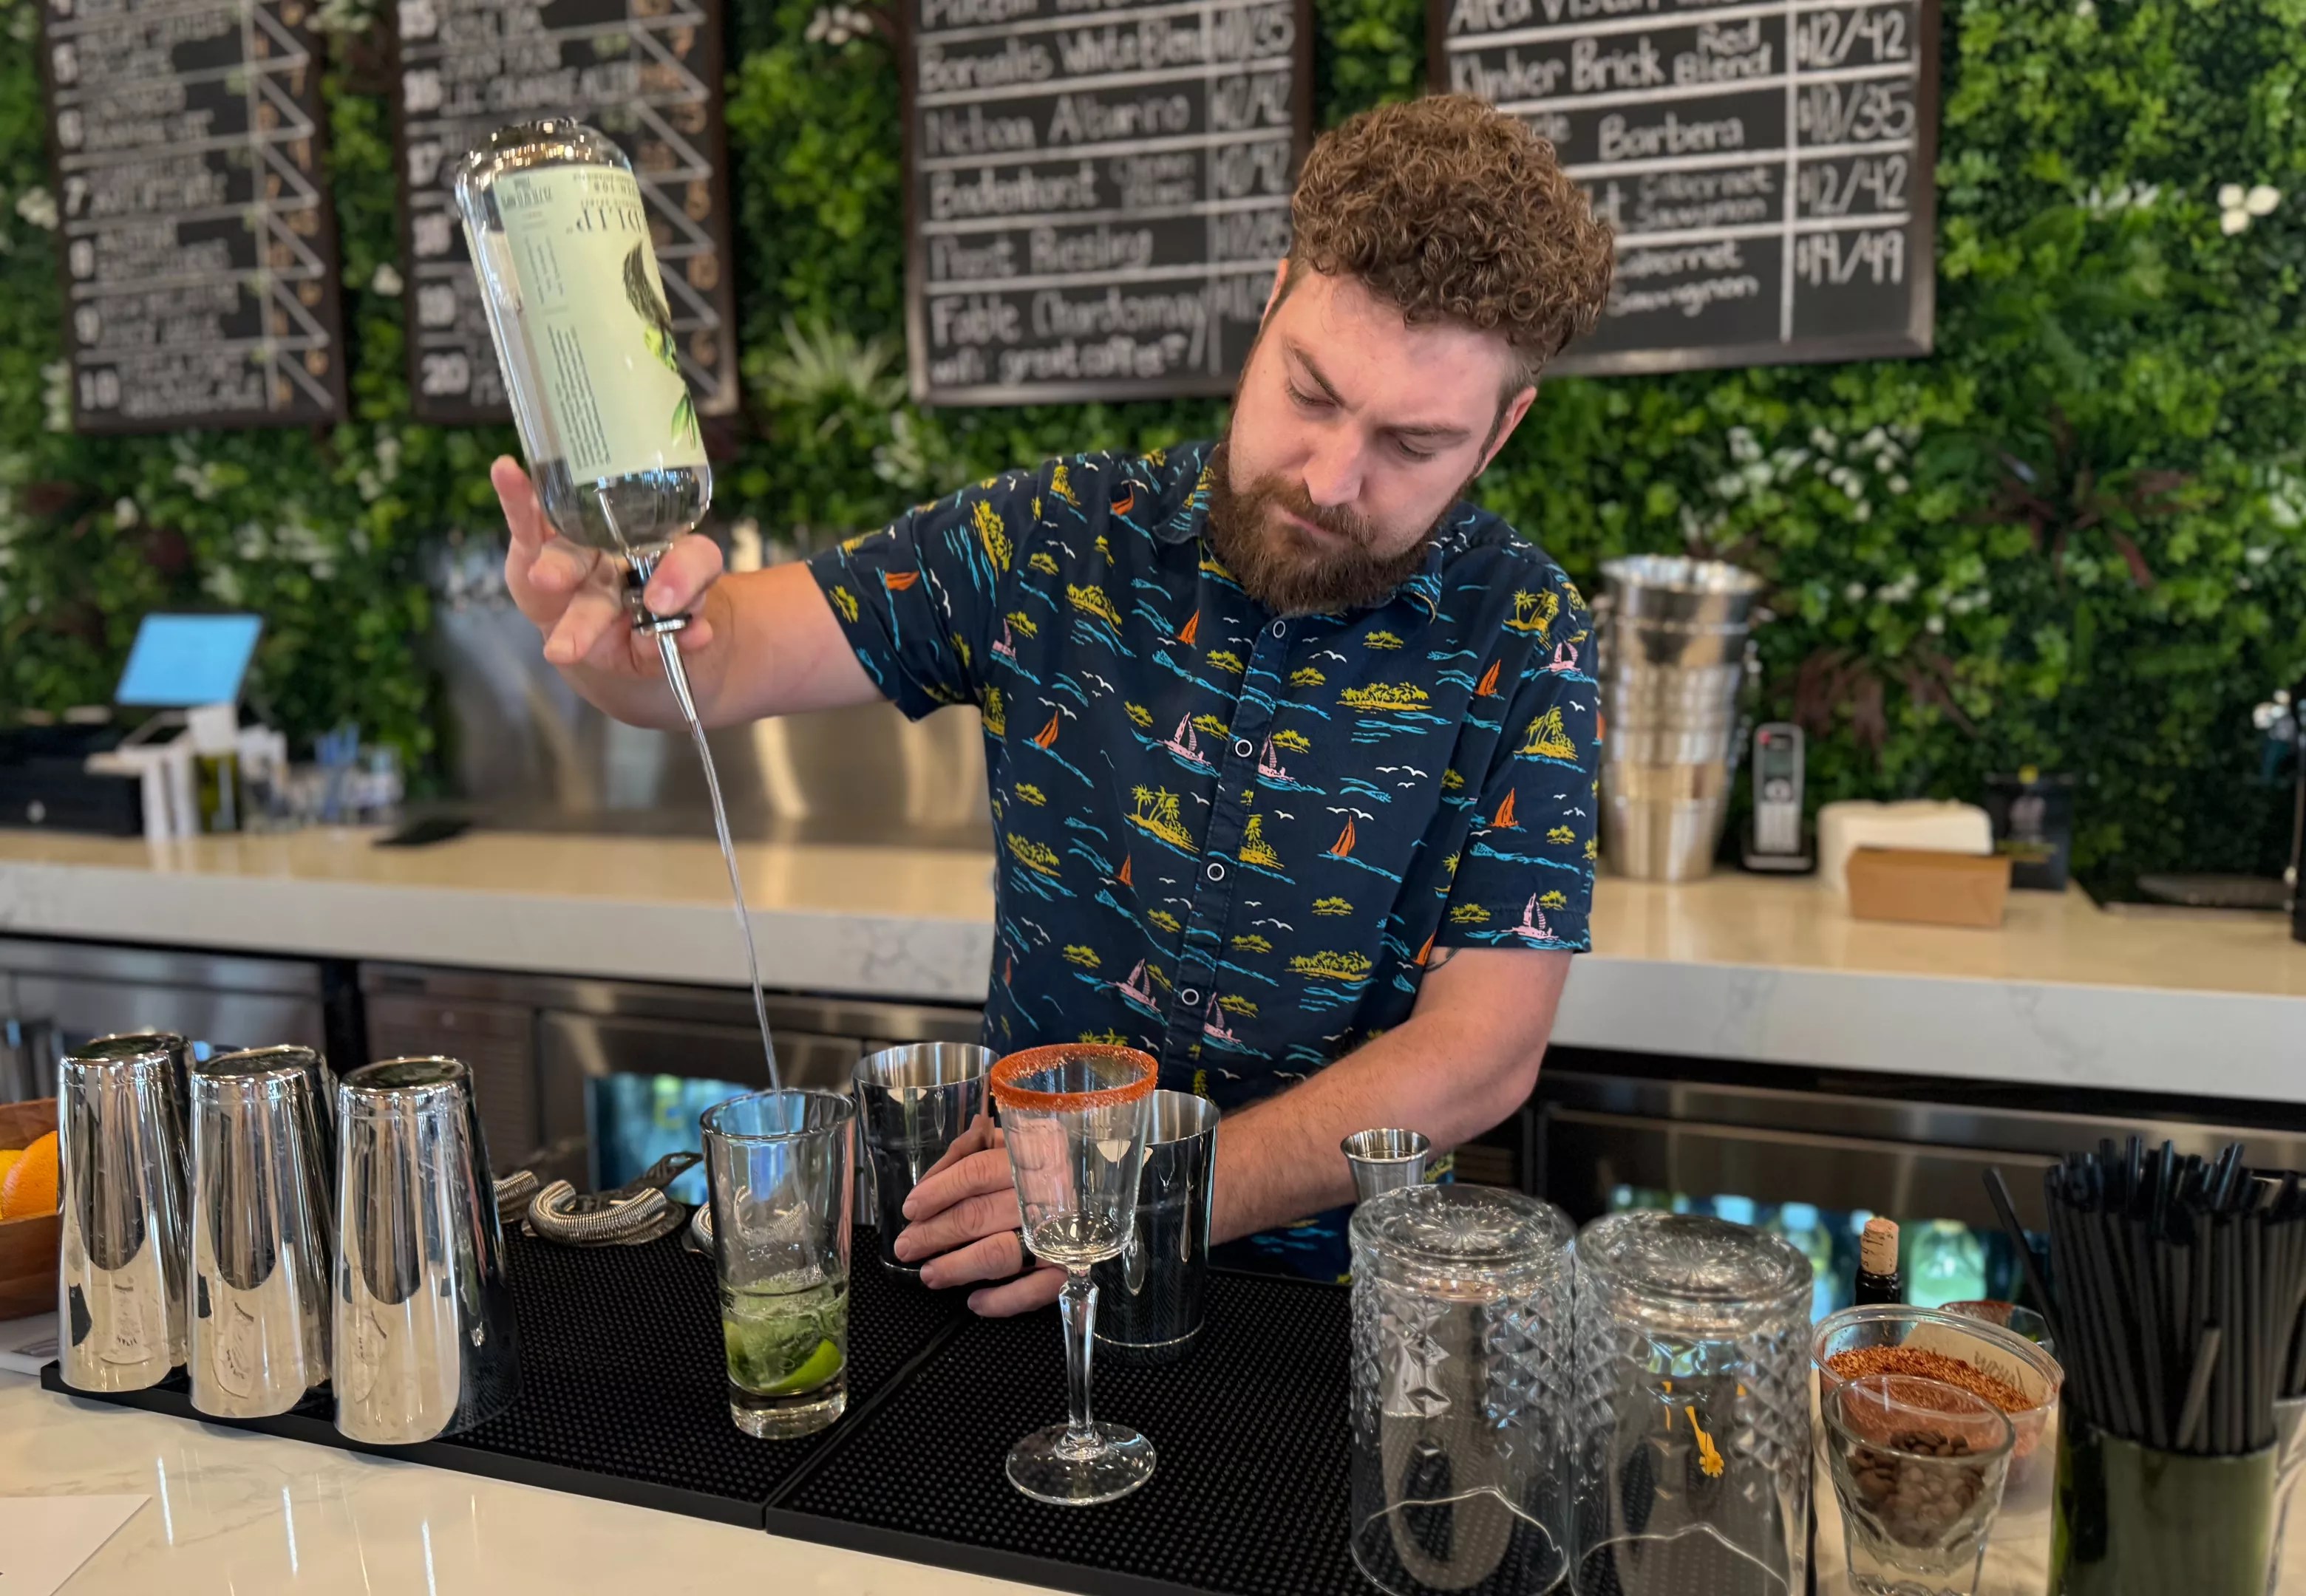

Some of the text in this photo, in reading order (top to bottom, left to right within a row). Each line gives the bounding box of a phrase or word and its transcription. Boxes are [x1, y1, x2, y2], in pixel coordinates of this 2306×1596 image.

[1571, 36, 1666, 92] Brick
[1698, 18, 1761, 55] Red
[1673, 42, 1772, 86] Blend
[1597, 111, 1744, 162] Barbera
